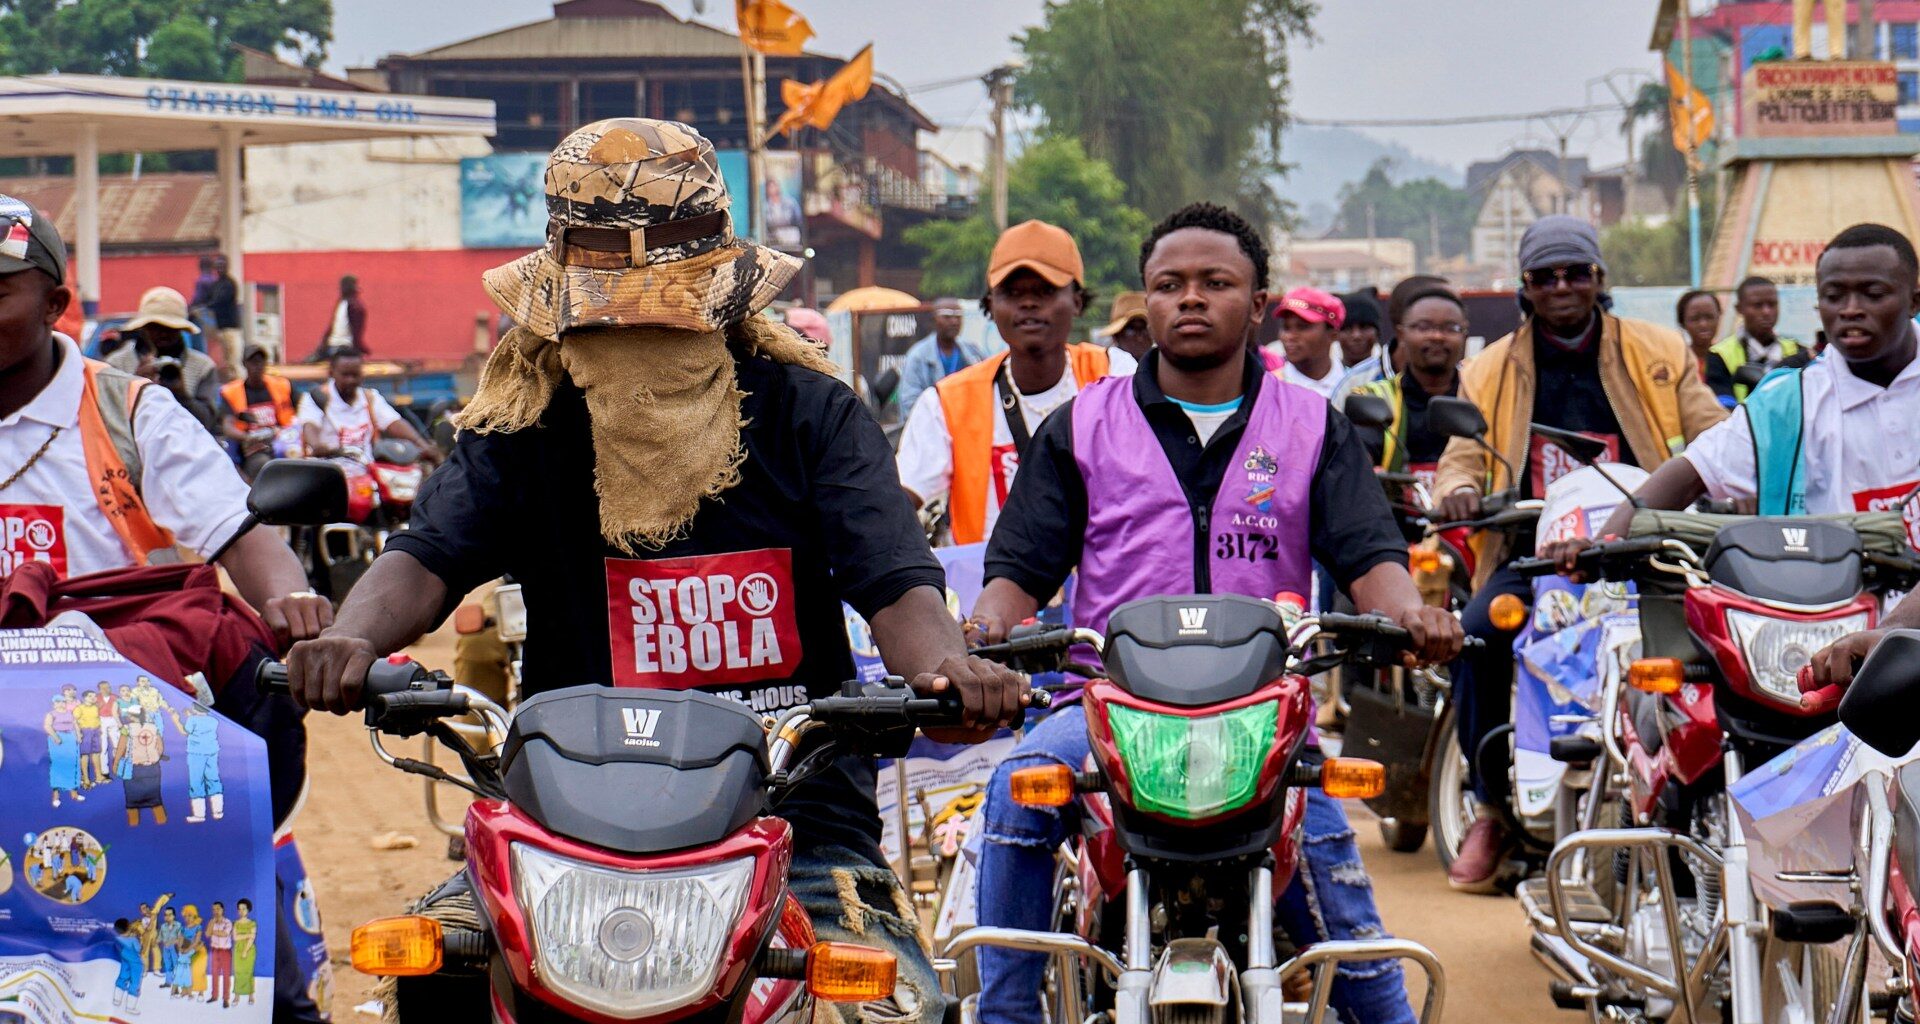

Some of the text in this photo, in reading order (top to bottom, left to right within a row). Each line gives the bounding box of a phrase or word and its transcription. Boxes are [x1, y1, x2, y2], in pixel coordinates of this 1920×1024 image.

[146, 86, 277, 115] STATION
[376, 102, 419, 121] OIL
[1247, 472, 1274, 482] RDC
[1231, 513, 1278, 529] A.C.CO
[1216, 532, 1279, 563] 3172
[629, 574, 736, 625] STOP
[57, 637, 93, 649] KWA
[633, 617, 783, 674] EBOLA
[2, 650, 39, 663] YETU
[41, 650, 78, 663] KWA
